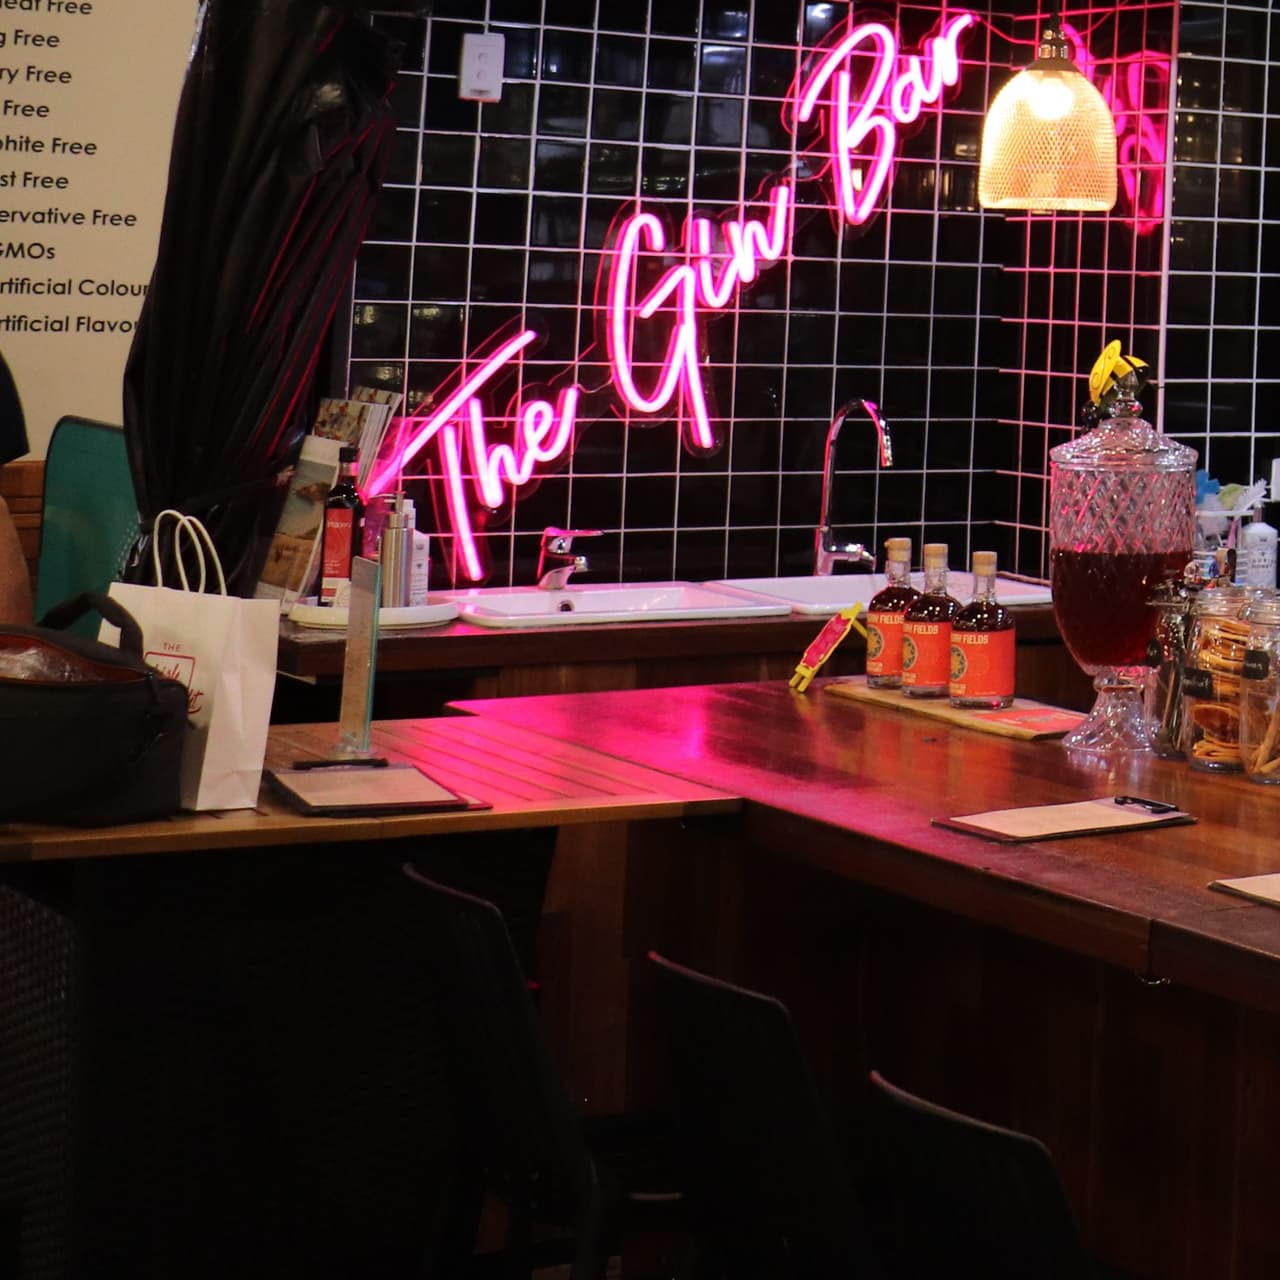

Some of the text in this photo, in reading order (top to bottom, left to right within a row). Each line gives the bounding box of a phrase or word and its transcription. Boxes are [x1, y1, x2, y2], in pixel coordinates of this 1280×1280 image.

[14, 29, 60, 48] Free
[26, 65, 72, 84] Free
[3, 99, 50, 118] Free
[800, 13, 977, 226] Bar
[52, 137, 98, 155] Free
[23, 171, 69, 189] Free
[92, 209, 138, 227] Free
[609, 184, 790, 450] Gin
[364, 329, 581, 583] The
[913, 624, 939, 635] FIELDS
[962, 634, 989, 645] FIELDS
